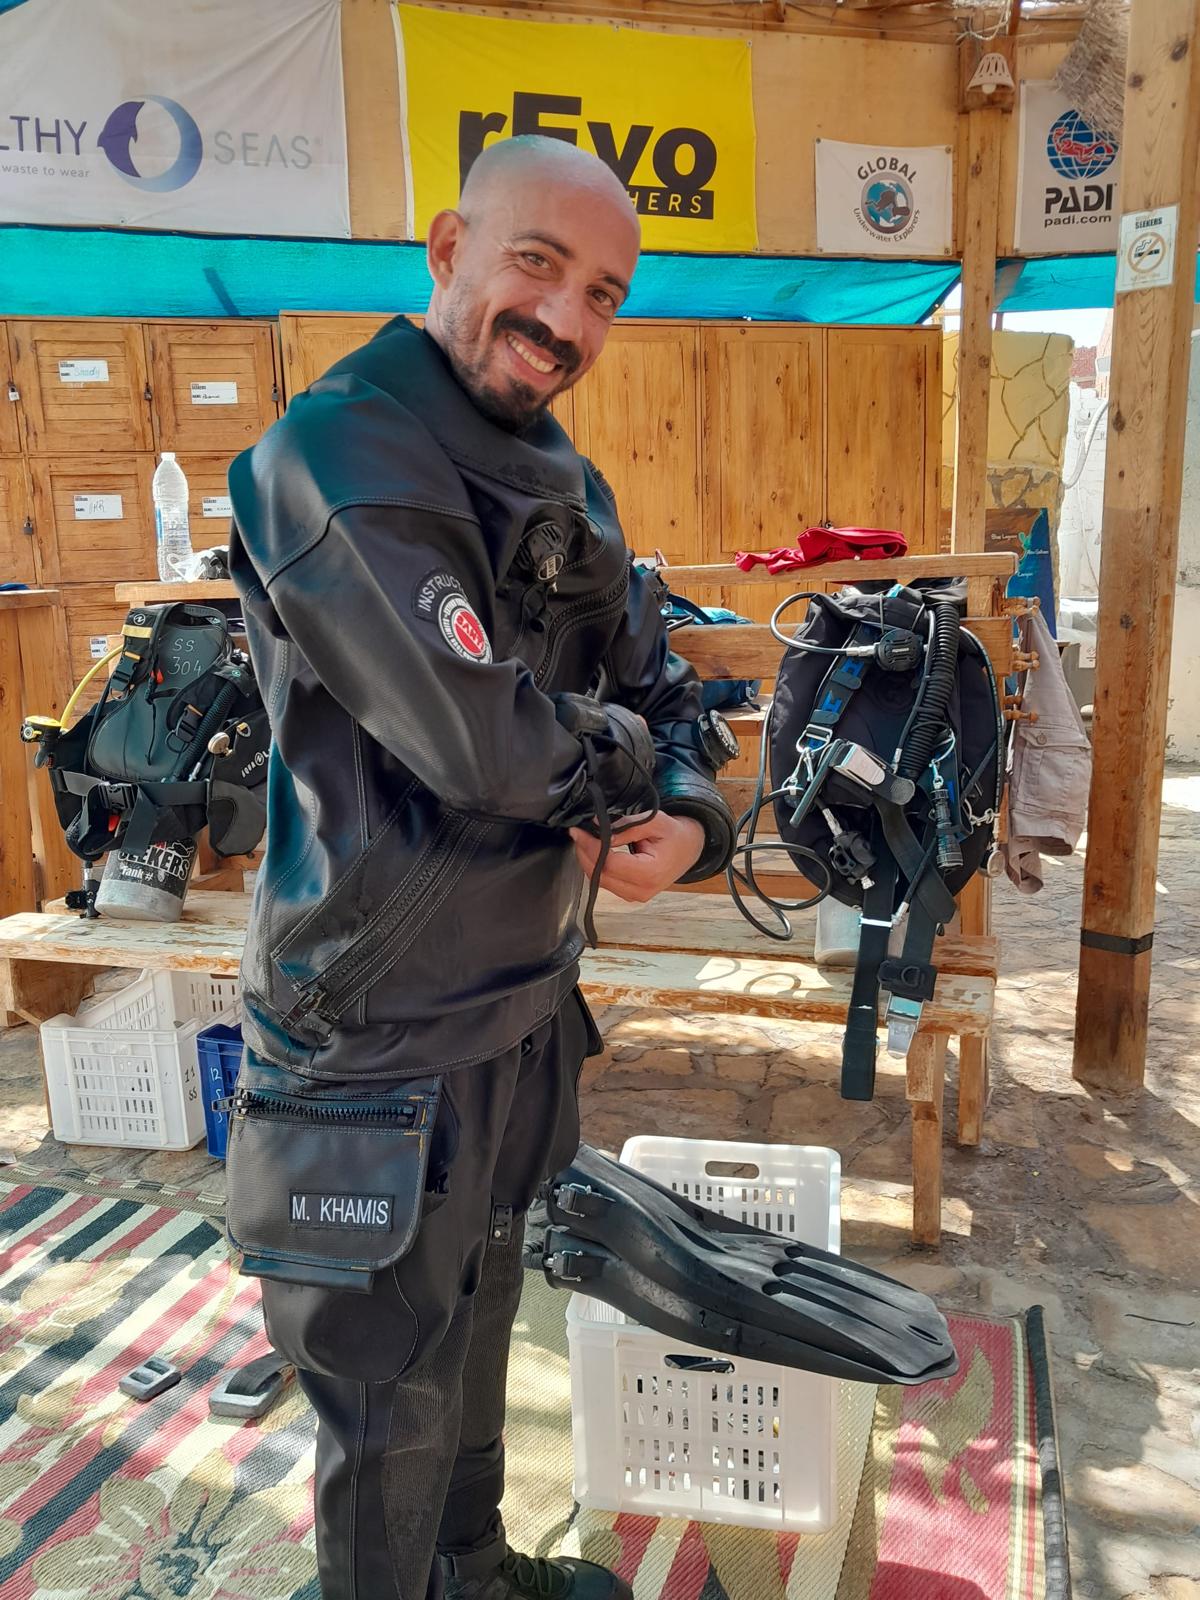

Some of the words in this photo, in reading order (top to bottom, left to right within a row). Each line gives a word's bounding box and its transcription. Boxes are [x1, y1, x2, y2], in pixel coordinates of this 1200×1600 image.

[0, 115, 87, 155] THY
[214, 131, 312, 170] SEAS
[2, 165, 38, 175] waste
[43, 166, 55, 176] to
[60, 168, 90, 178] wear
[857, 156, 917, 184] GLOBAL
[1045, 184, 1113, 214] PADI
[853, 207, 891, 242] Underwater
[893, 208, 920, 242] Explorers
[1044, 215, 1112, 228] padi.com
[167, 656, 201, 677] 304
[210, 1066, 223, 1081] 12
[292, 1195, 310, 1221] M.
[320, 1197, 389, 1225] KHAMIS
